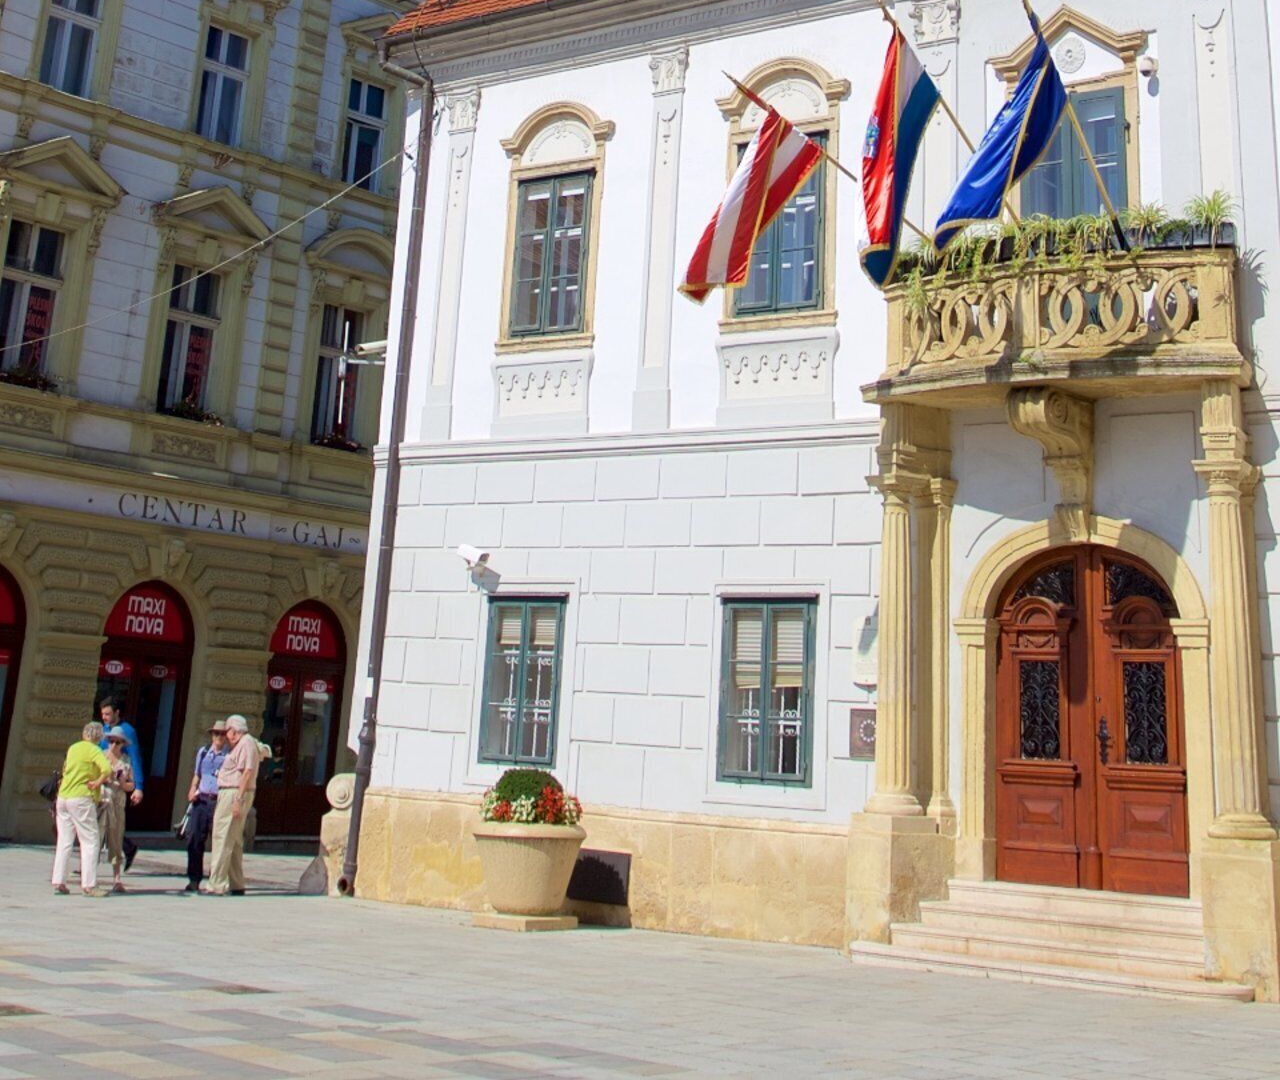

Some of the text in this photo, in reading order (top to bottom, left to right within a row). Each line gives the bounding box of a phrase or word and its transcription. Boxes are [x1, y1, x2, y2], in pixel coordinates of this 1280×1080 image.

[118, 492, 247, 535] CENTAR
[127, 595, 167, 616] MAXI
[124, 615, 164, 635] NOVA
[287, 615, 321, 635] MAXI
[285, 634, 320, 653] NOVA
